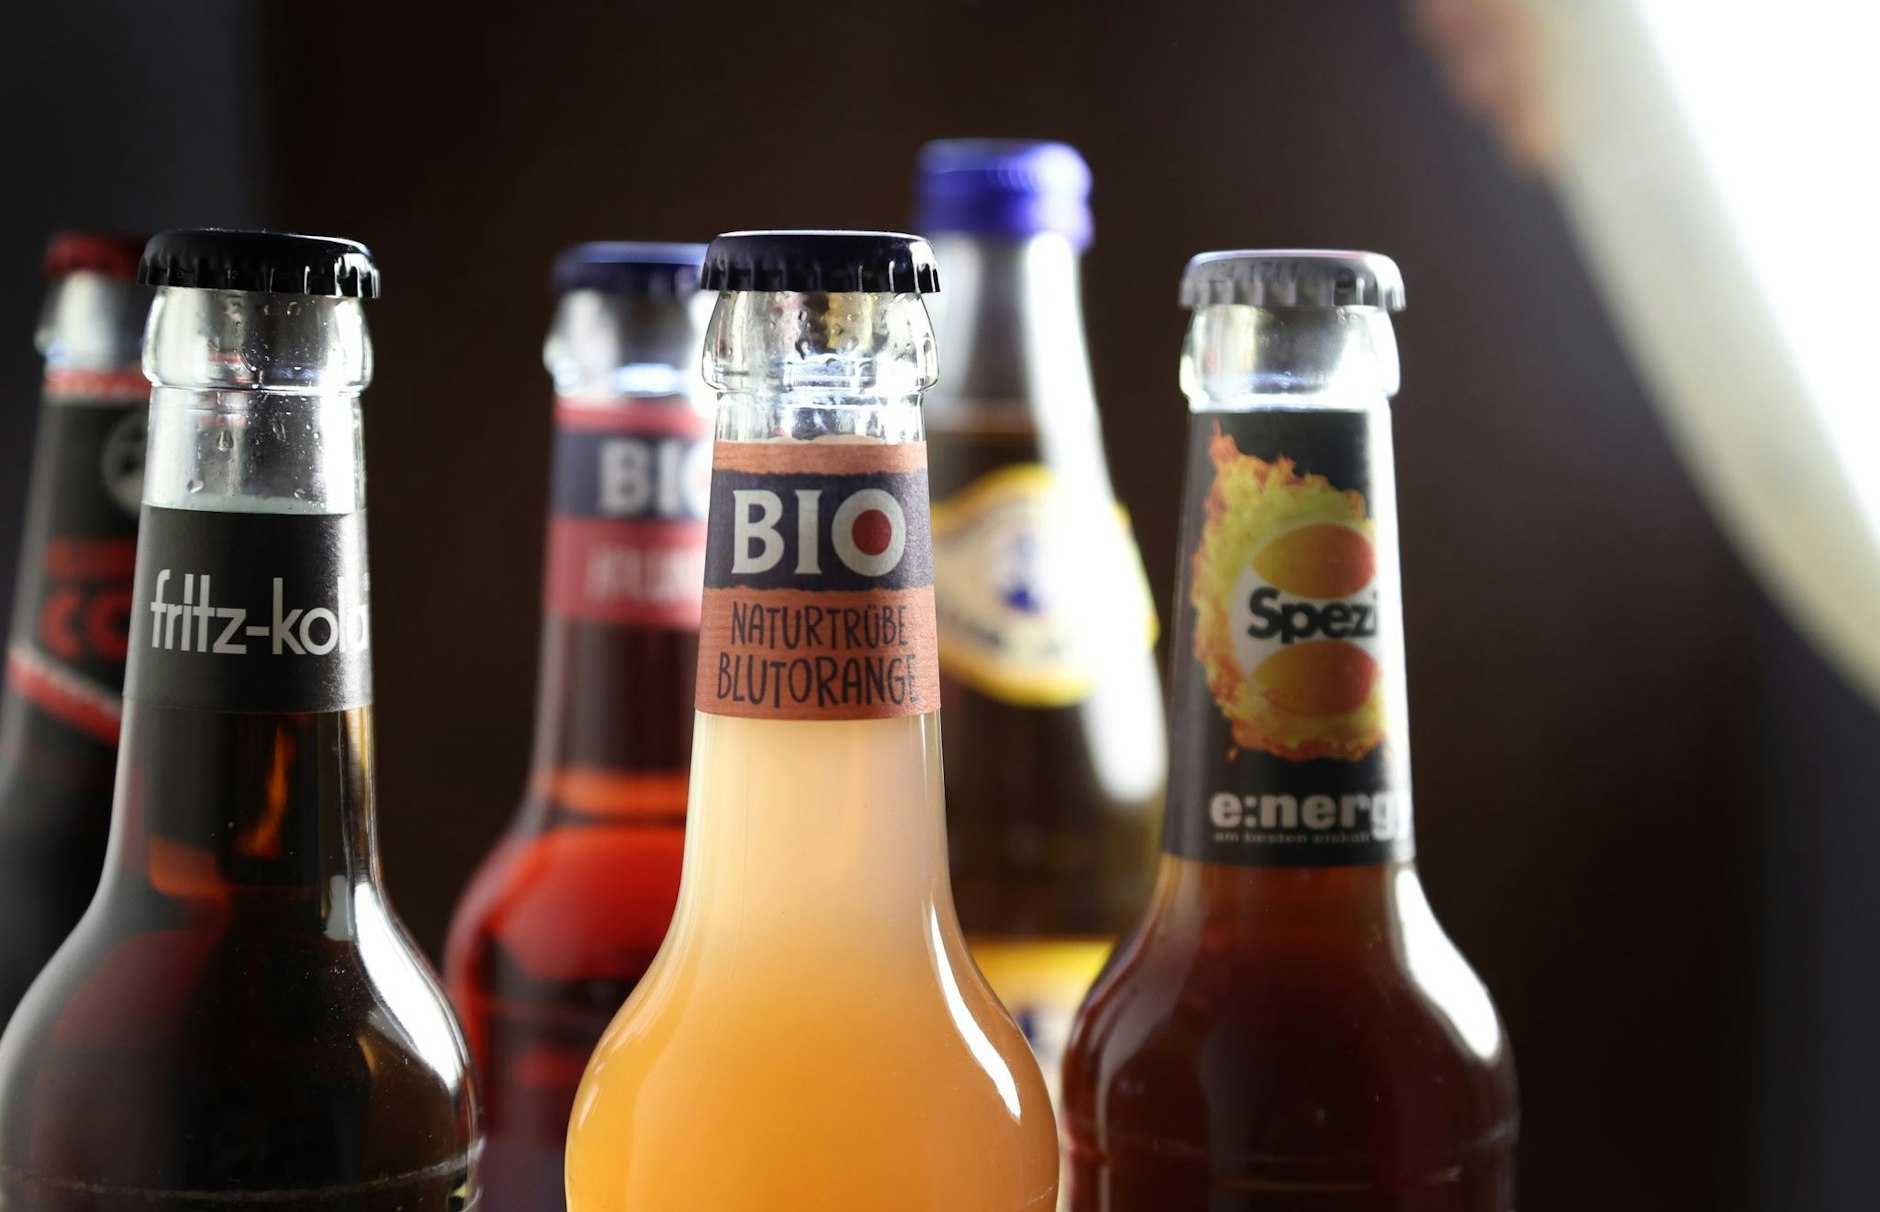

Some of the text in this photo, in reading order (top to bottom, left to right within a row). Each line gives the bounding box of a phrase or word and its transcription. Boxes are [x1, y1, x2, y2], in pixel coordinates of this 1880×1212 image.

[731, 488, 907, 577] BIO
[731, 600, 907, 651] NATURTRÜBE
[717, 652, 919, 708] BLUTORANGE
[1215, 832, 1239, 843] am
[1245, 831, 1308, 844] besten
